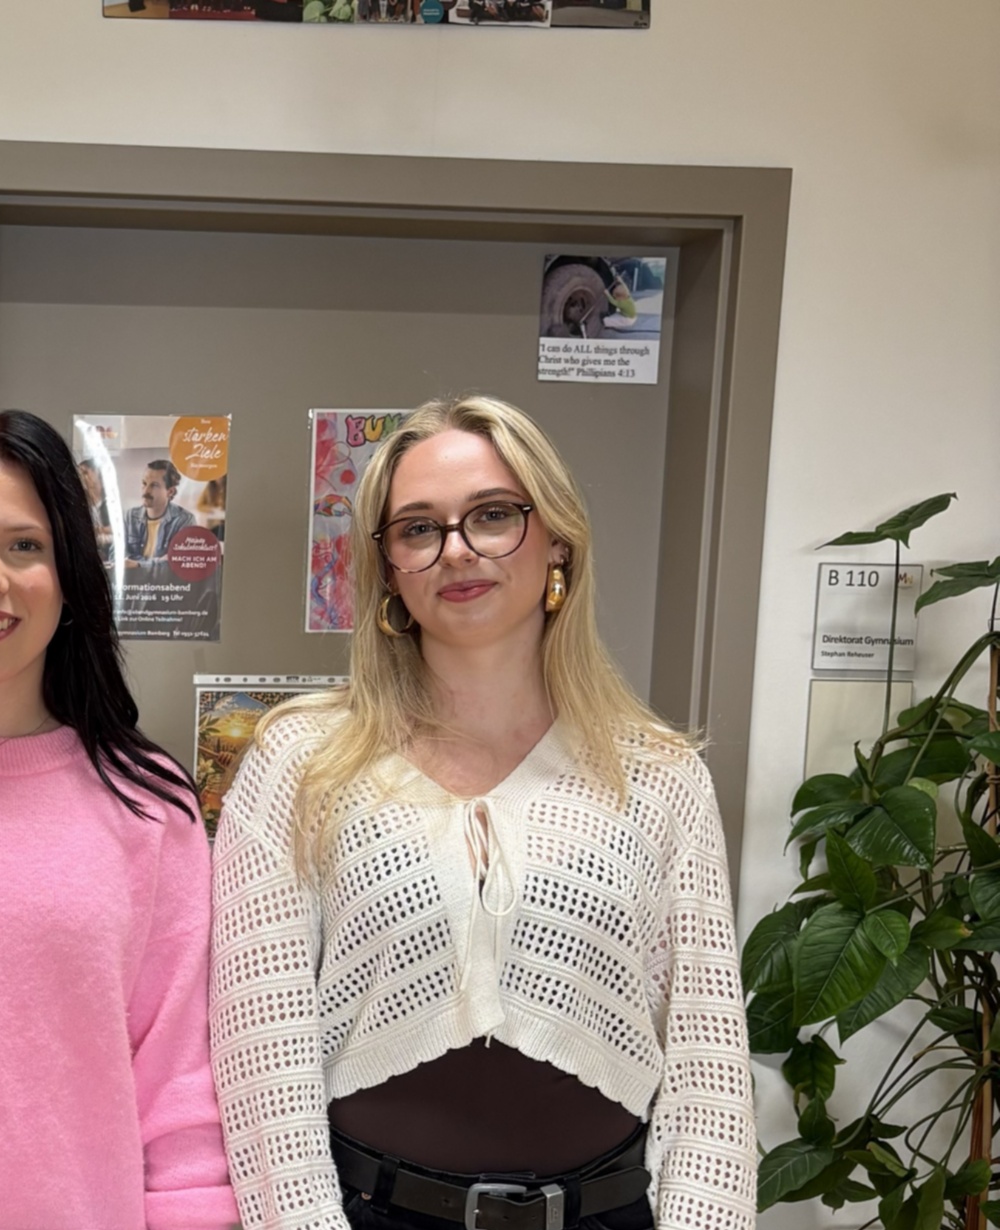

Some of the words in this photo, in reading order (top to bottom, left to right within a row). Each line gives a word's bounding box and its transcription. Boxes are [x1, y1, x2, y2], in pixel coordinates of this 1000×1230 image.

[562, 344, 572, 353] do
[574, 345, 592, 354] ALL
[594, 345, 617, 356] things
[619, 345, 650, 357] through
[539, 355, 562, 364] Christ
[564, 356, 580, 365] who
[581, 356, 601, 367] gives
[603, 358, 615, 366] me
[617, 357, 630, 366] the
[617, 369, 635, 377] 4:13
[183, 427, 226, 442] starken
[185, 443, 223, 460] Ziele
[828, 569, 839, 586] B
[845, 570, 880, 588] 110
[112, 583, 191, 592] Iormationsabend
[822, 634, 863, 644] Direktorat
